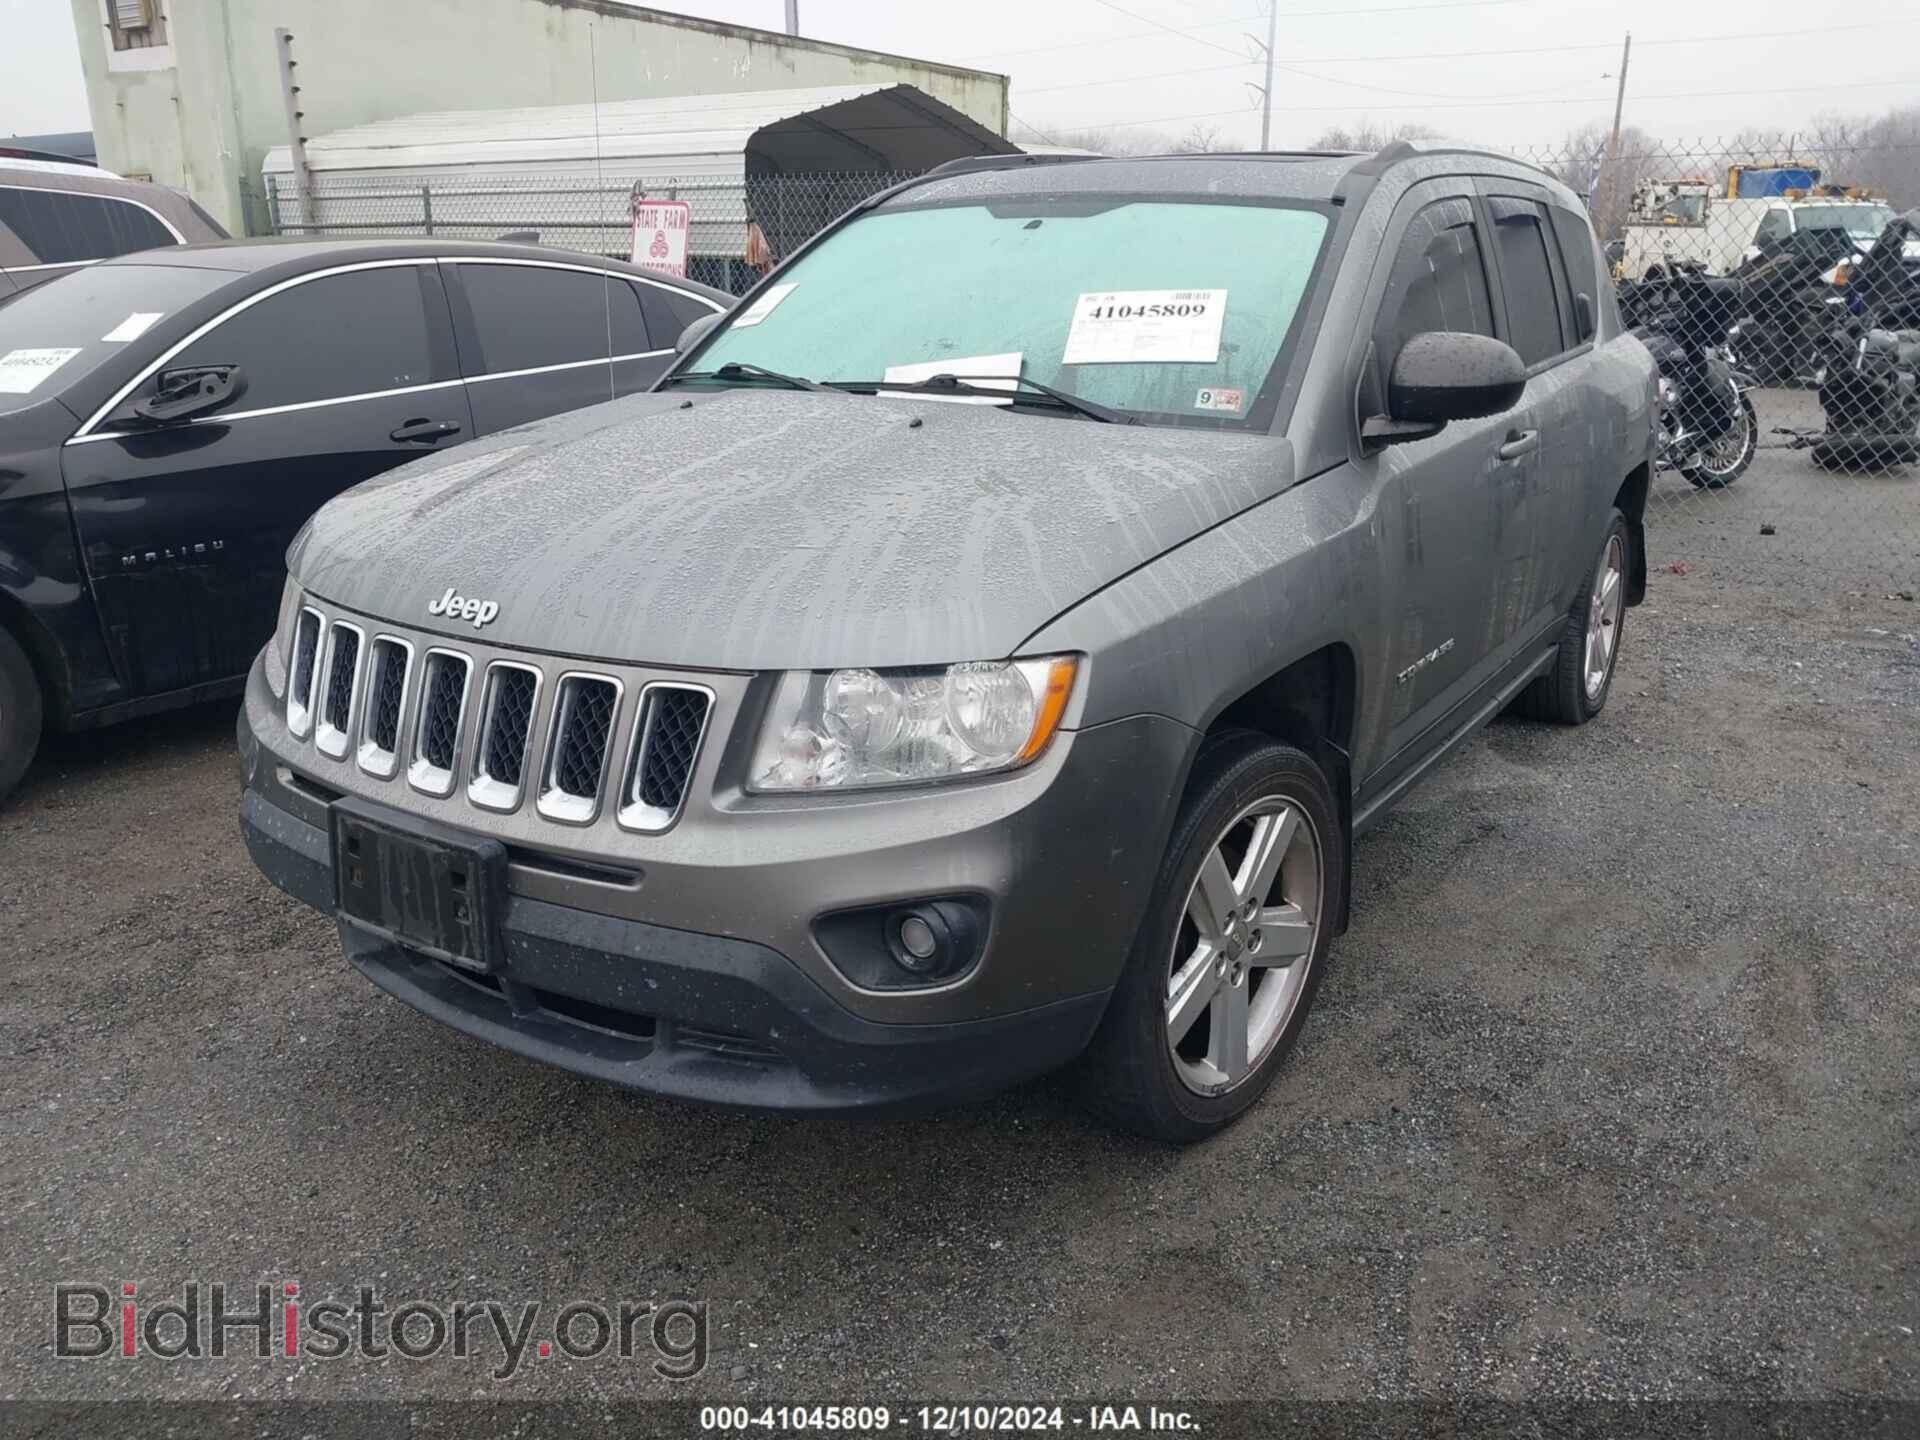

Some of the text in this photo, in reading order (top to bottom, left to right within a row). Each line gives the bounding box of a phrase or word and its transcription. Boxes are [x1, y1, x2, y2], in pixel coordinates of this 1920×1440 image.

[1089, 304, 1206, 318] 41045809
[1200, 391, 1211, 404] 9
[121, 540, 224, 565] MALIBU
[428, 588, 500, 630] Jeep
